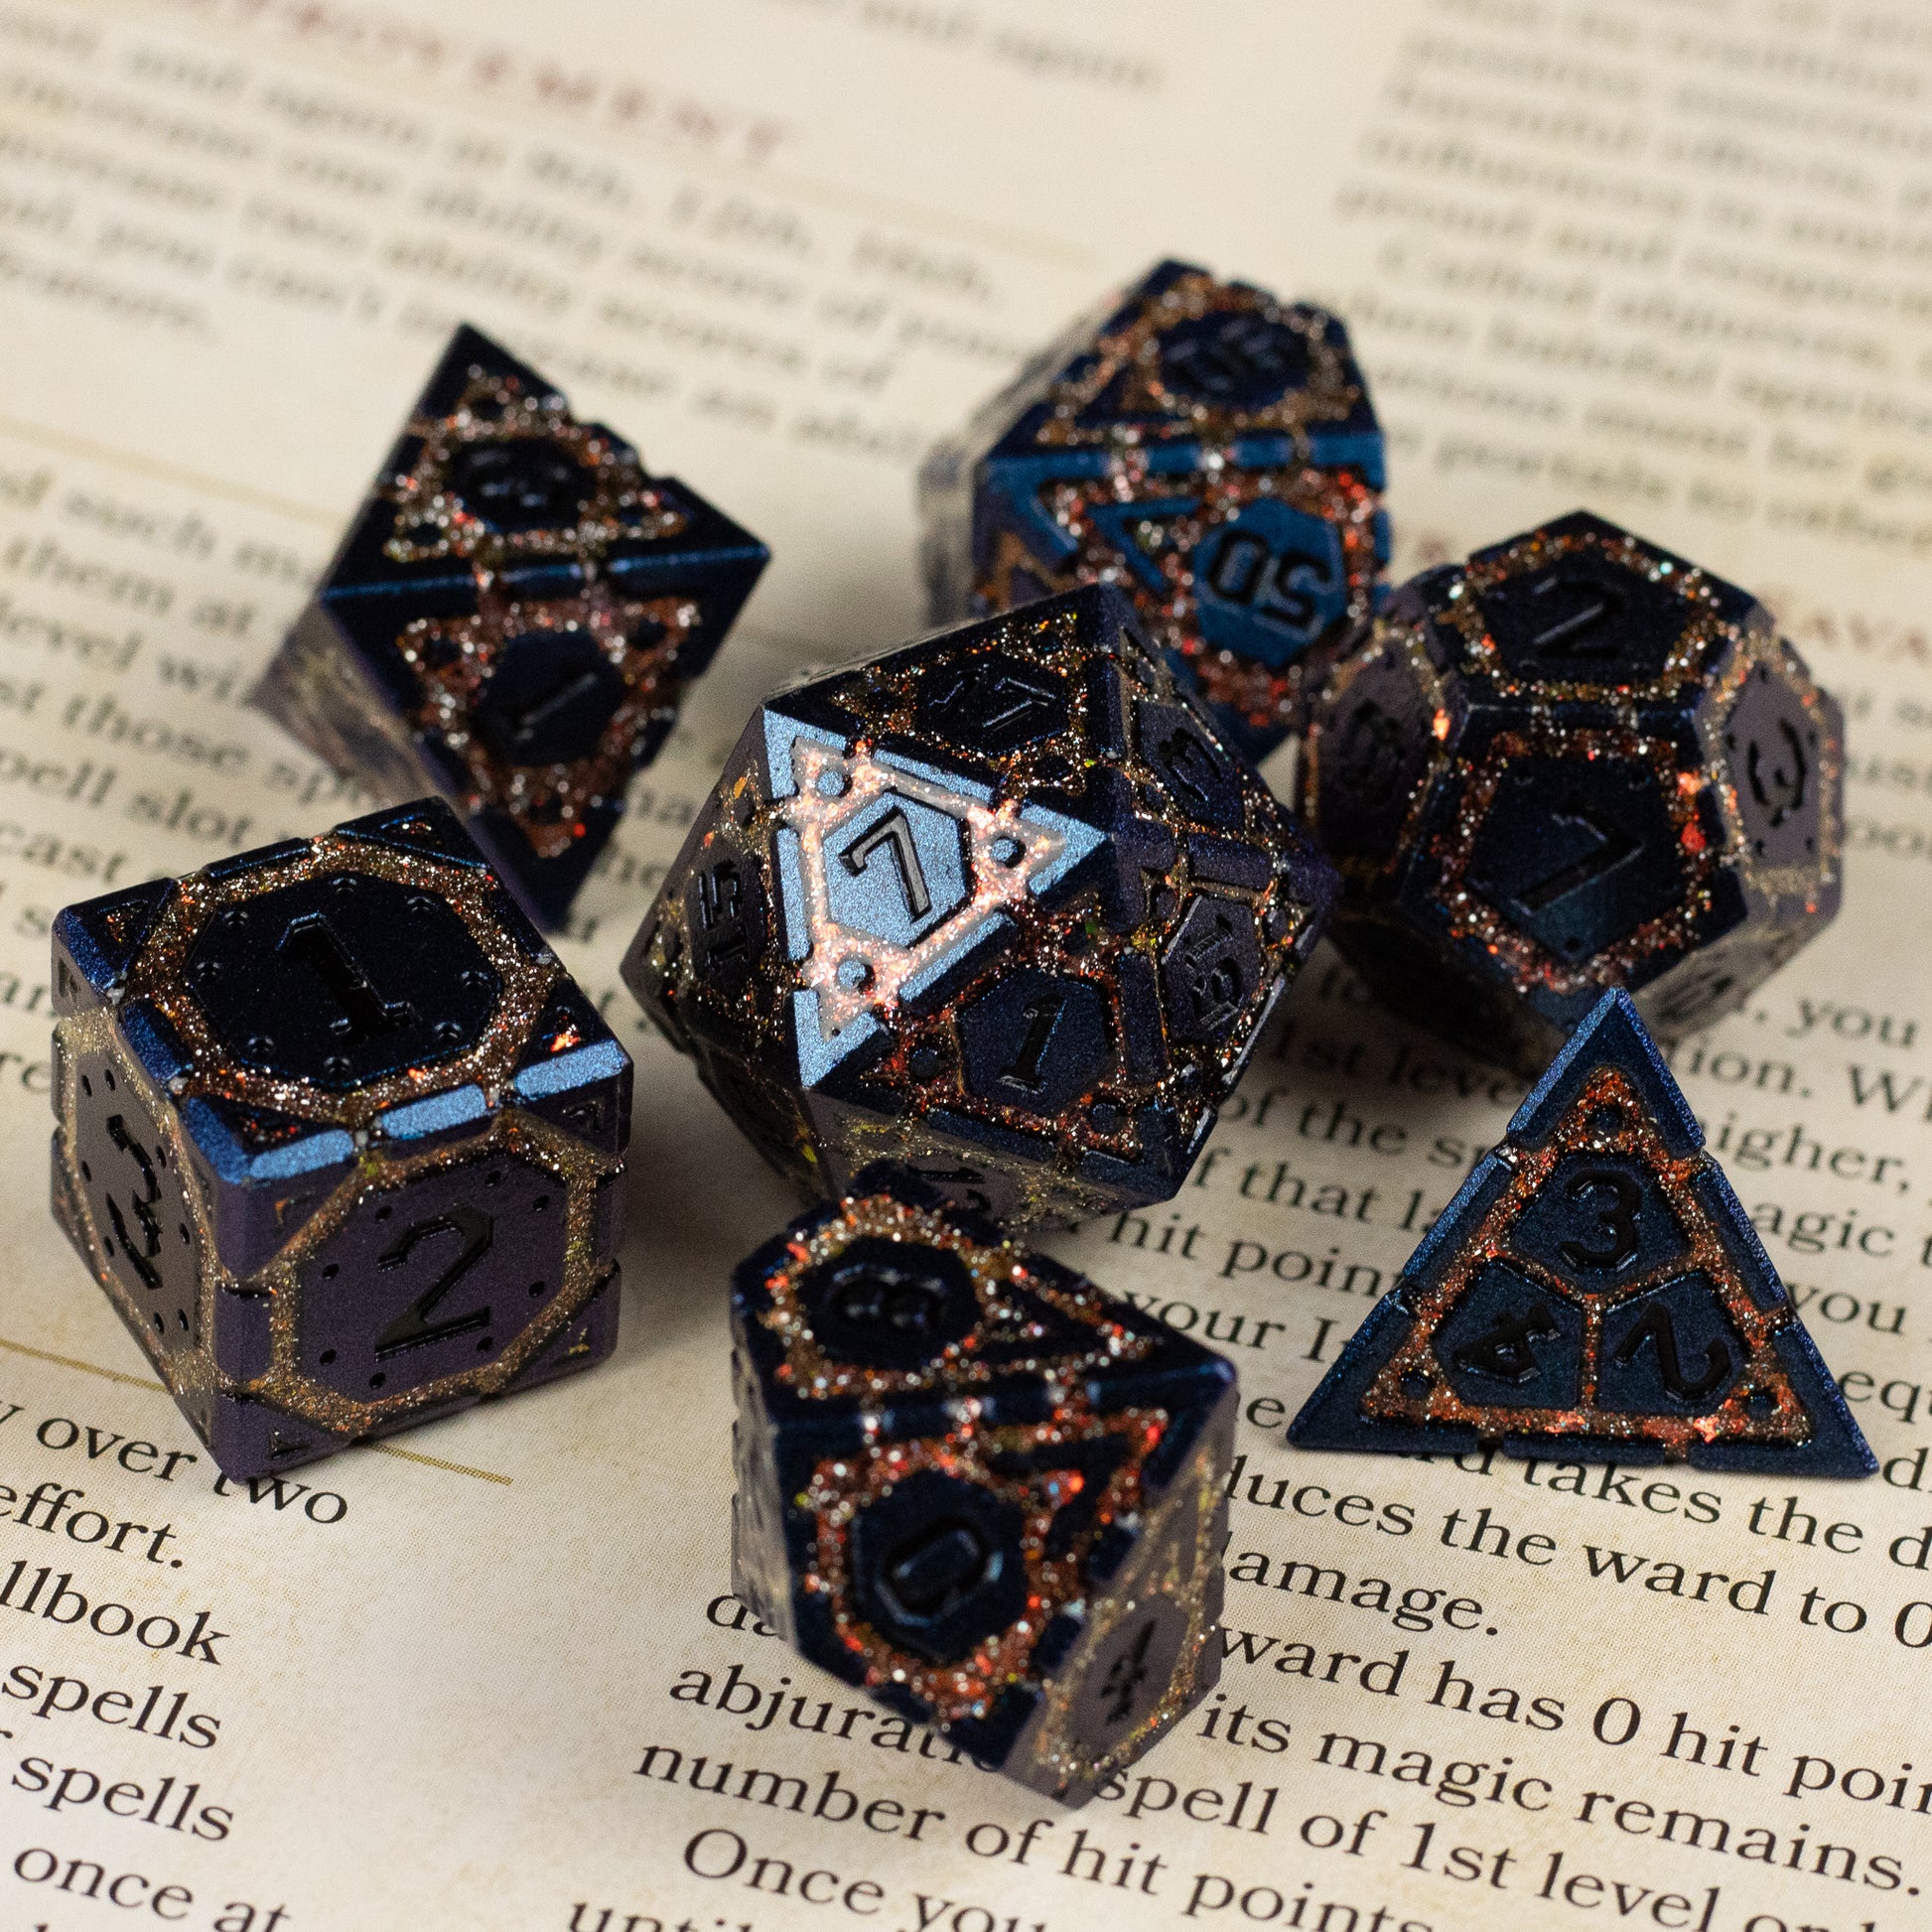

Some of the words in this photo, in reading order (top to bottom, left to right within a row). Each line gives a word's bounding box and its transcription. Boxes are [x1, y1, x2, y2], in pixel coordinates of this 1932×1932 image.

[127, 787, 254, 849] slot
[838, 803, 932, 923] 7
[1785, 997, 1917, 1050] you
[1300, 1100, 1407, 1157] the
[1697, 1110, 1909, 1192] igher,
[1107, 1212, 1207, 1261] hit
[1240, 1161, 1381, 1224] that
[1561, 1170, 1642, 1273] 3
[1752, 1201, 1895, 1259] agic
[373, 1202, 494, 1363] 2
[1613, 1300, 1731, 1405] 2
[1838, 1370, 1932, 1426] eq
[36, 1417, 199, 1482] over
[1524, 1459, 1724, 1524] takes
[1749, 1495, 1863, 1554] the
[1223, 1532, 1499, 1637] amage.
[1441, 1507, 1557, 1566] the
[1583, 1544, 1777, 1615] ward
[1800, 1587, 1868, 1634] to
[1, 1664, 221, 1749] spells
[1220, 1626, 1410, 1698] ward
[1426, 1660, 1566, 1731] has
[1592, 1697, 1642, 1747] 0
[1659, 1712, 1769, 1777] hit
[11, 1755, 234, 1843] spells
[632, 1743, 947, 1843] number
[965, 1819, 1054, 1866] of
[1057, 1828, 1169, 1896] hit
[669, 1664, 997, 1773] abjurati
[1095, 1768, 1280, 1836] spell
[1299, 1809, 1388, 1858] of
[1399, 1821, 1517, 1890] 1st
[1535, 1851, 1721, 1932] level
[1196, 1693, 1292, 1753] its
[1311, 1731, 1554, 1813] magic
[1574, 1788, 1921, 1896] remains.
[13, 1847, 194, 1921] once
[683, 1827, 885, 1915] Once
